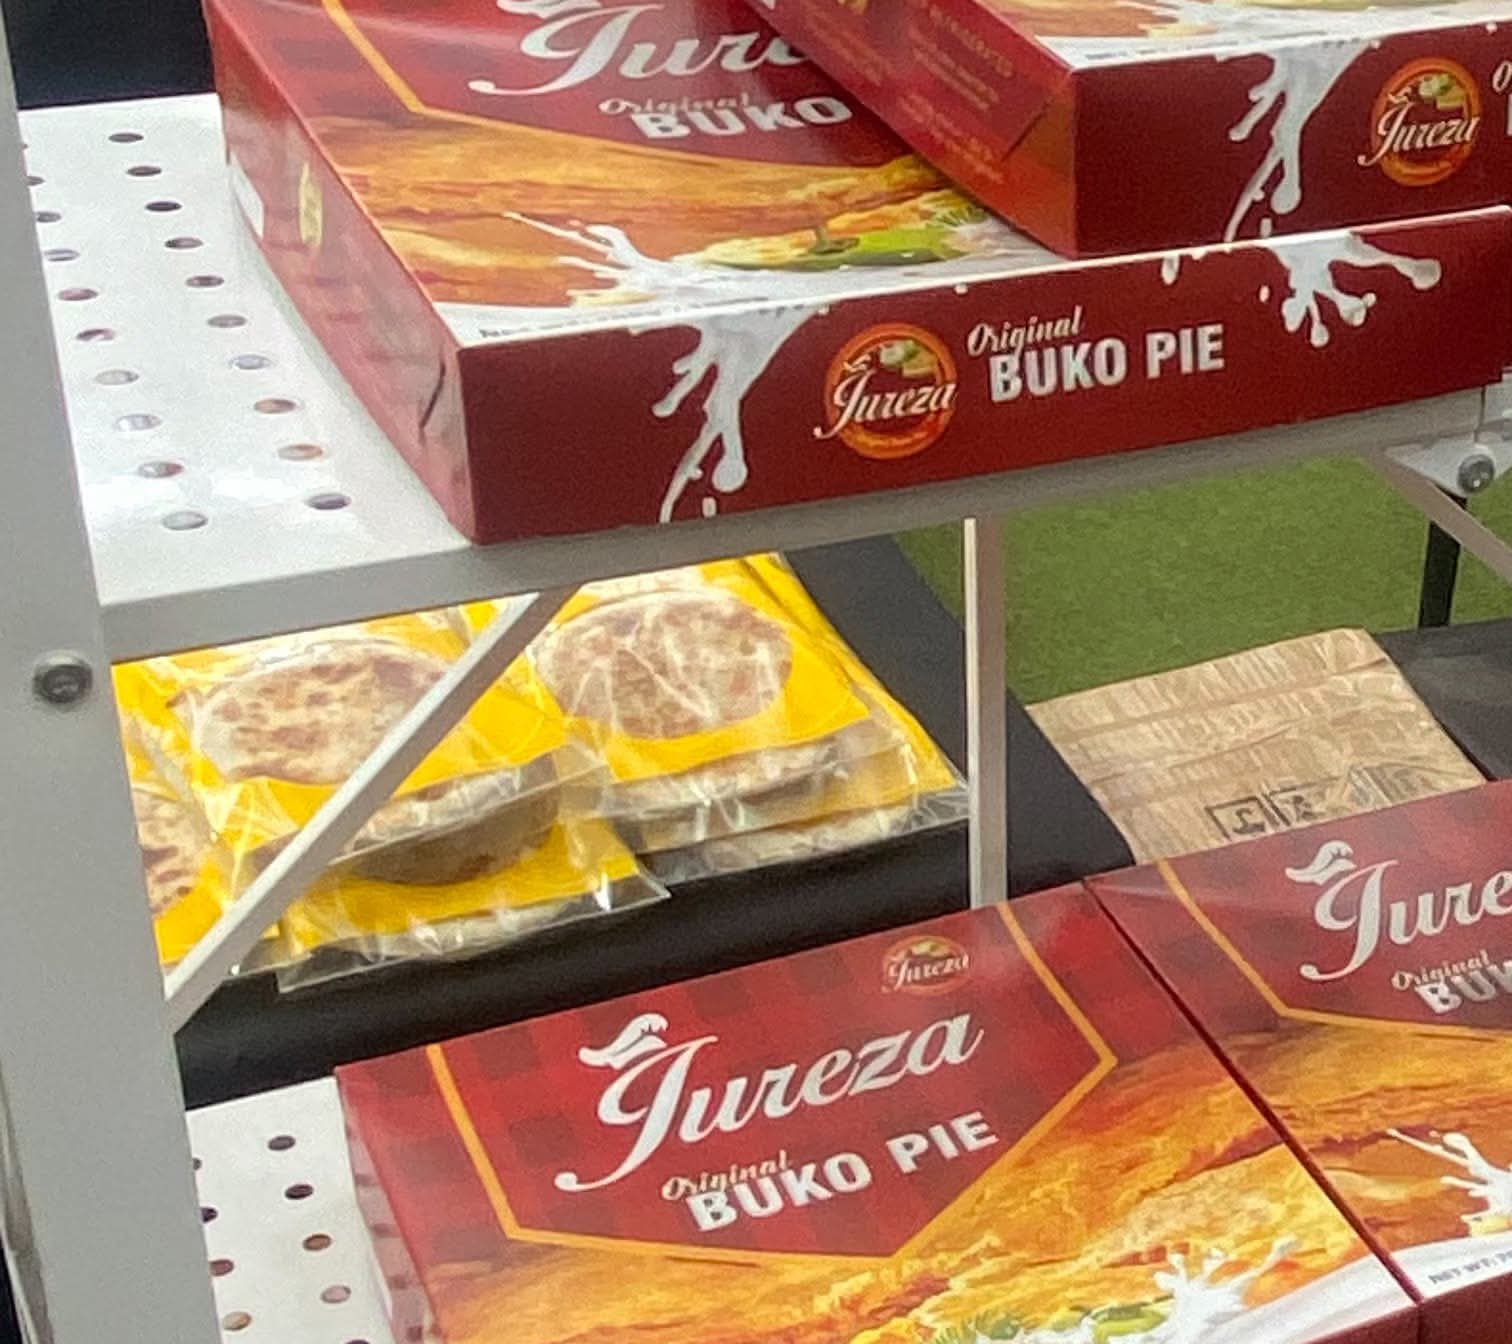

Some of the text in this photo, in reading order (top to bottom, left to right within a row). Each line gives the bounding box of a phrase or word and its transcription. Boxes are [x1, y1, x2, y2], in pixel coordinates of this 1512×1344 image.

[631, 96, 853, 139] BUKO
[1357, 105, 1480, 166] Jureza
[967, 305, 1085, 356] Original
[989, 323, 1226, 403] BUKO PIE
[812, 369, 958, 440] Jureza
[1391, 949, 1490, 991] Original
[554, 1013, 985, 1191] Jureza
[661, 1150, 793, 1202] Original
[686, 1111, 1000, 1233] BUKO PIE
